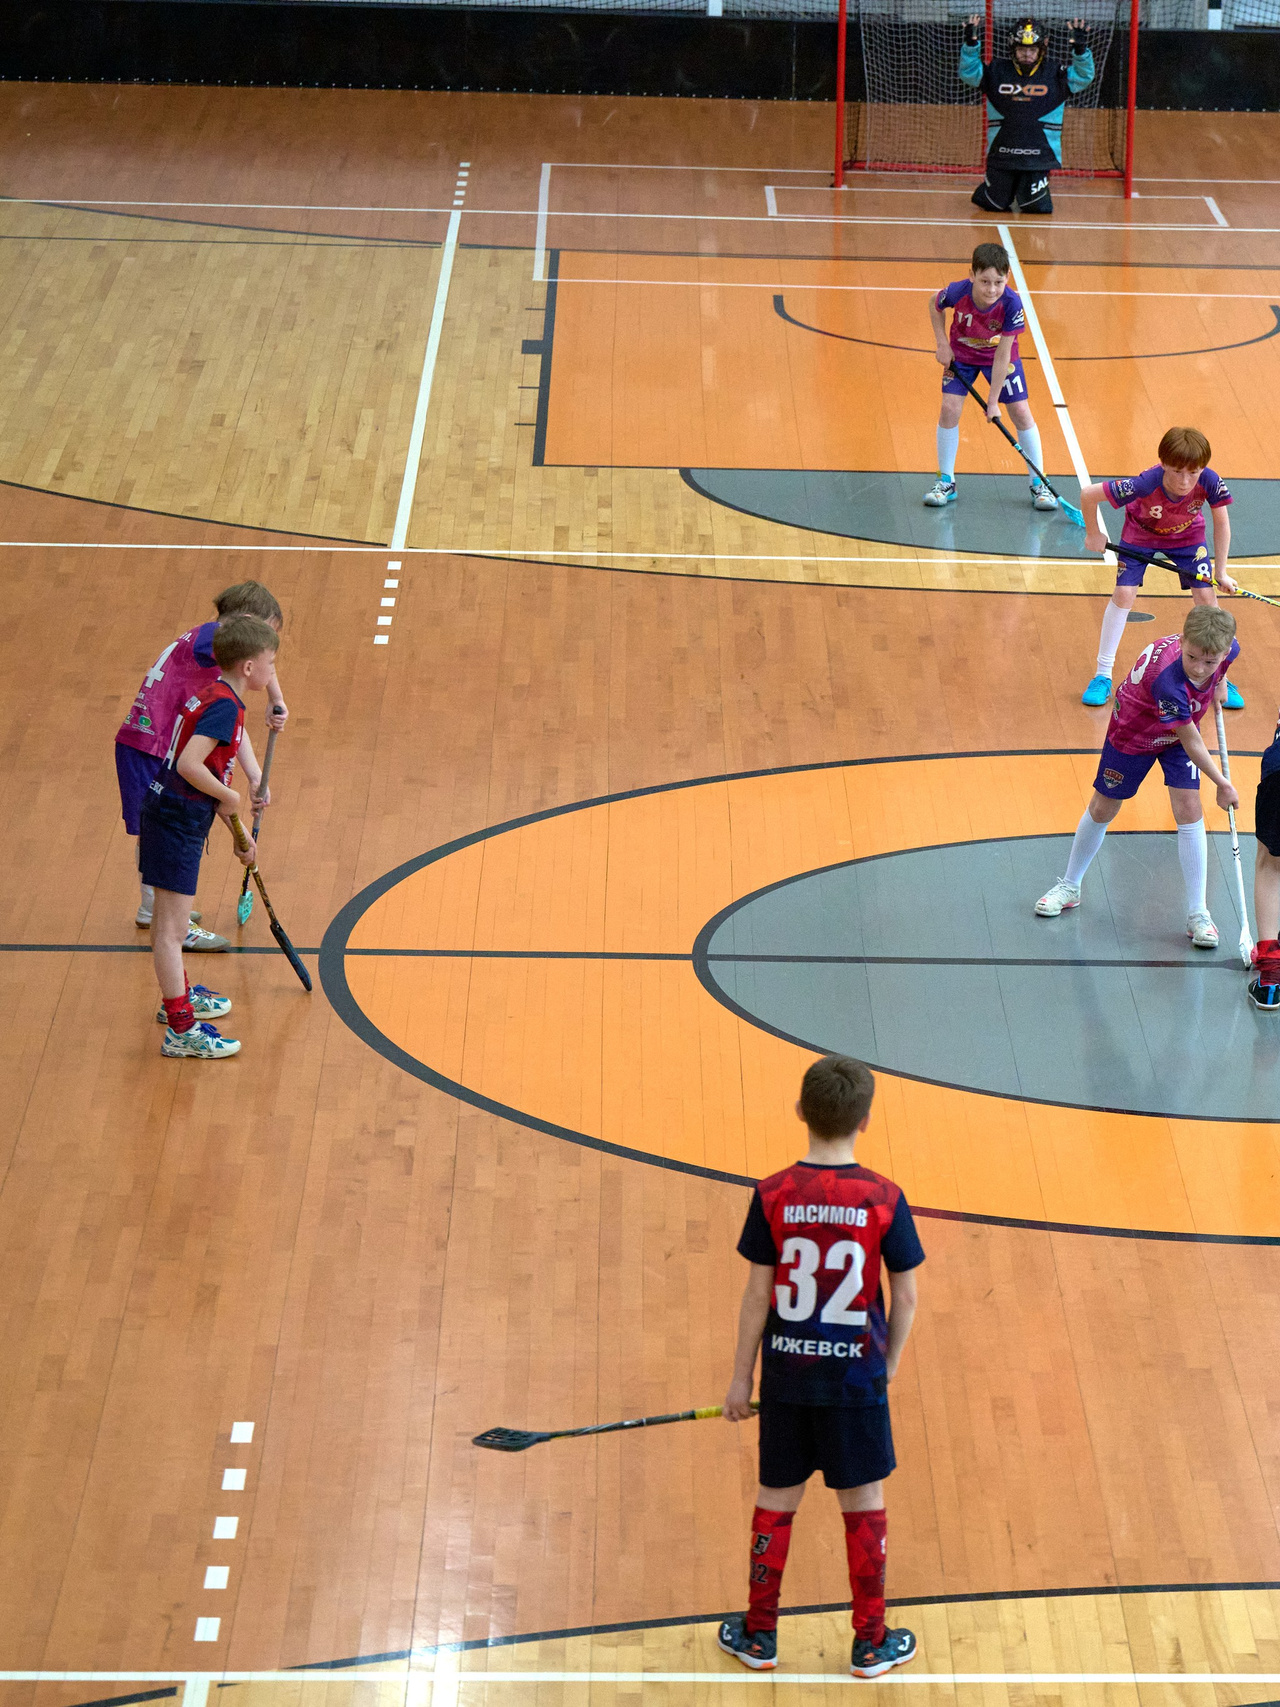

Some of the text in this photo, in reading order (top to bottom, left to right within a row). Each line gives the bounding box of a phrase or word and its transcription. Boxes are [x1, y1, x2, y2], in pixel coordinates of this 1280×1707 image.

[957, 311, 973, 327] 11
[1002, 375, 1024, 396] 11
[1149, 505, 1163, 519] 8
[1197, 562, 1210, 578] 8
[783, 1205, 868, 1227] КАСИМОВ
[775, 1236, 867, 1326] 32
[771, 1334, 864, 1358] ИЖЕВСК
